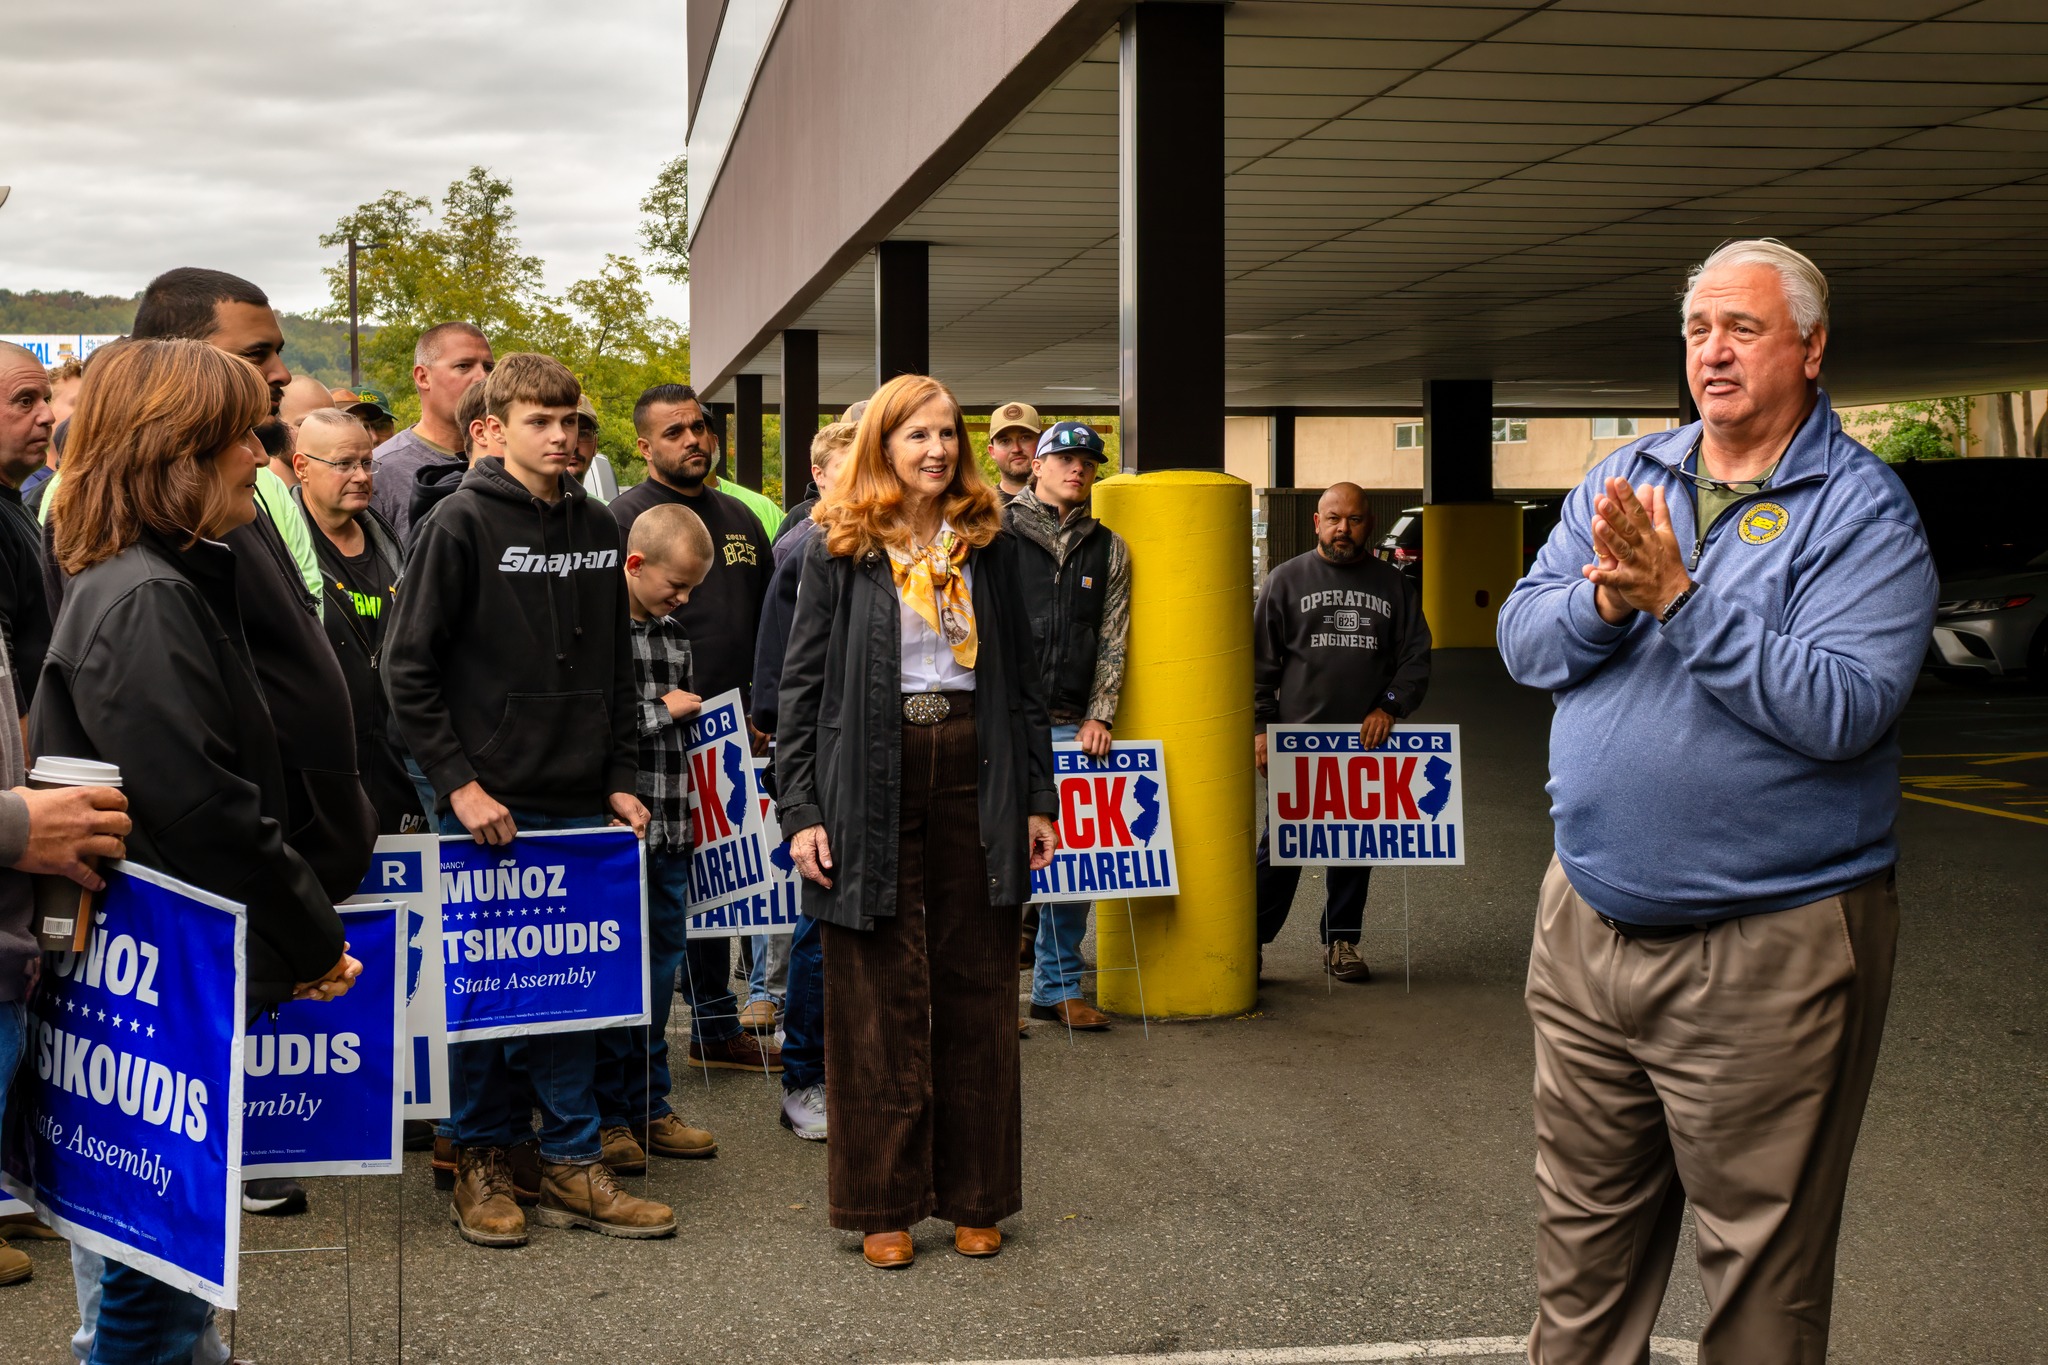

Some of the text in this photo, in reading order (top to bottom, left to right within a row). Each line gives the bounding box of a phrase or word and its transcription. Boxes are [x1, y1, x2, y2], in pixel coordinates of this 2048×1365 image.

[24, 343, 52, 365] TAL
[498, 546, 617, 577] Snap-on
[722, 541, 757, 566] 825
[1300, 590, 1392, 619] OPERATING
[1338, 617, 1355, 627] 825
[683, 711, 732, 746] NOR
[1283, 736, 1444, 750] GOVENOR
[1277, 756, 1421, 820] JACK
[399, 813, 427, 834] CAT
[1051, 777, 1135, 850] CK
[1278, 823, 1456, 859] CIATTARELLI
[440, 861, 465, 870] NANCY
[440, 859, 568, 905] MUÑOZ
[443, 920, 621, 965] TSIKOUDIS
[452, 966, 596, 995] State Assembly
[31, 1104, 173, 1197] tate Assembly
